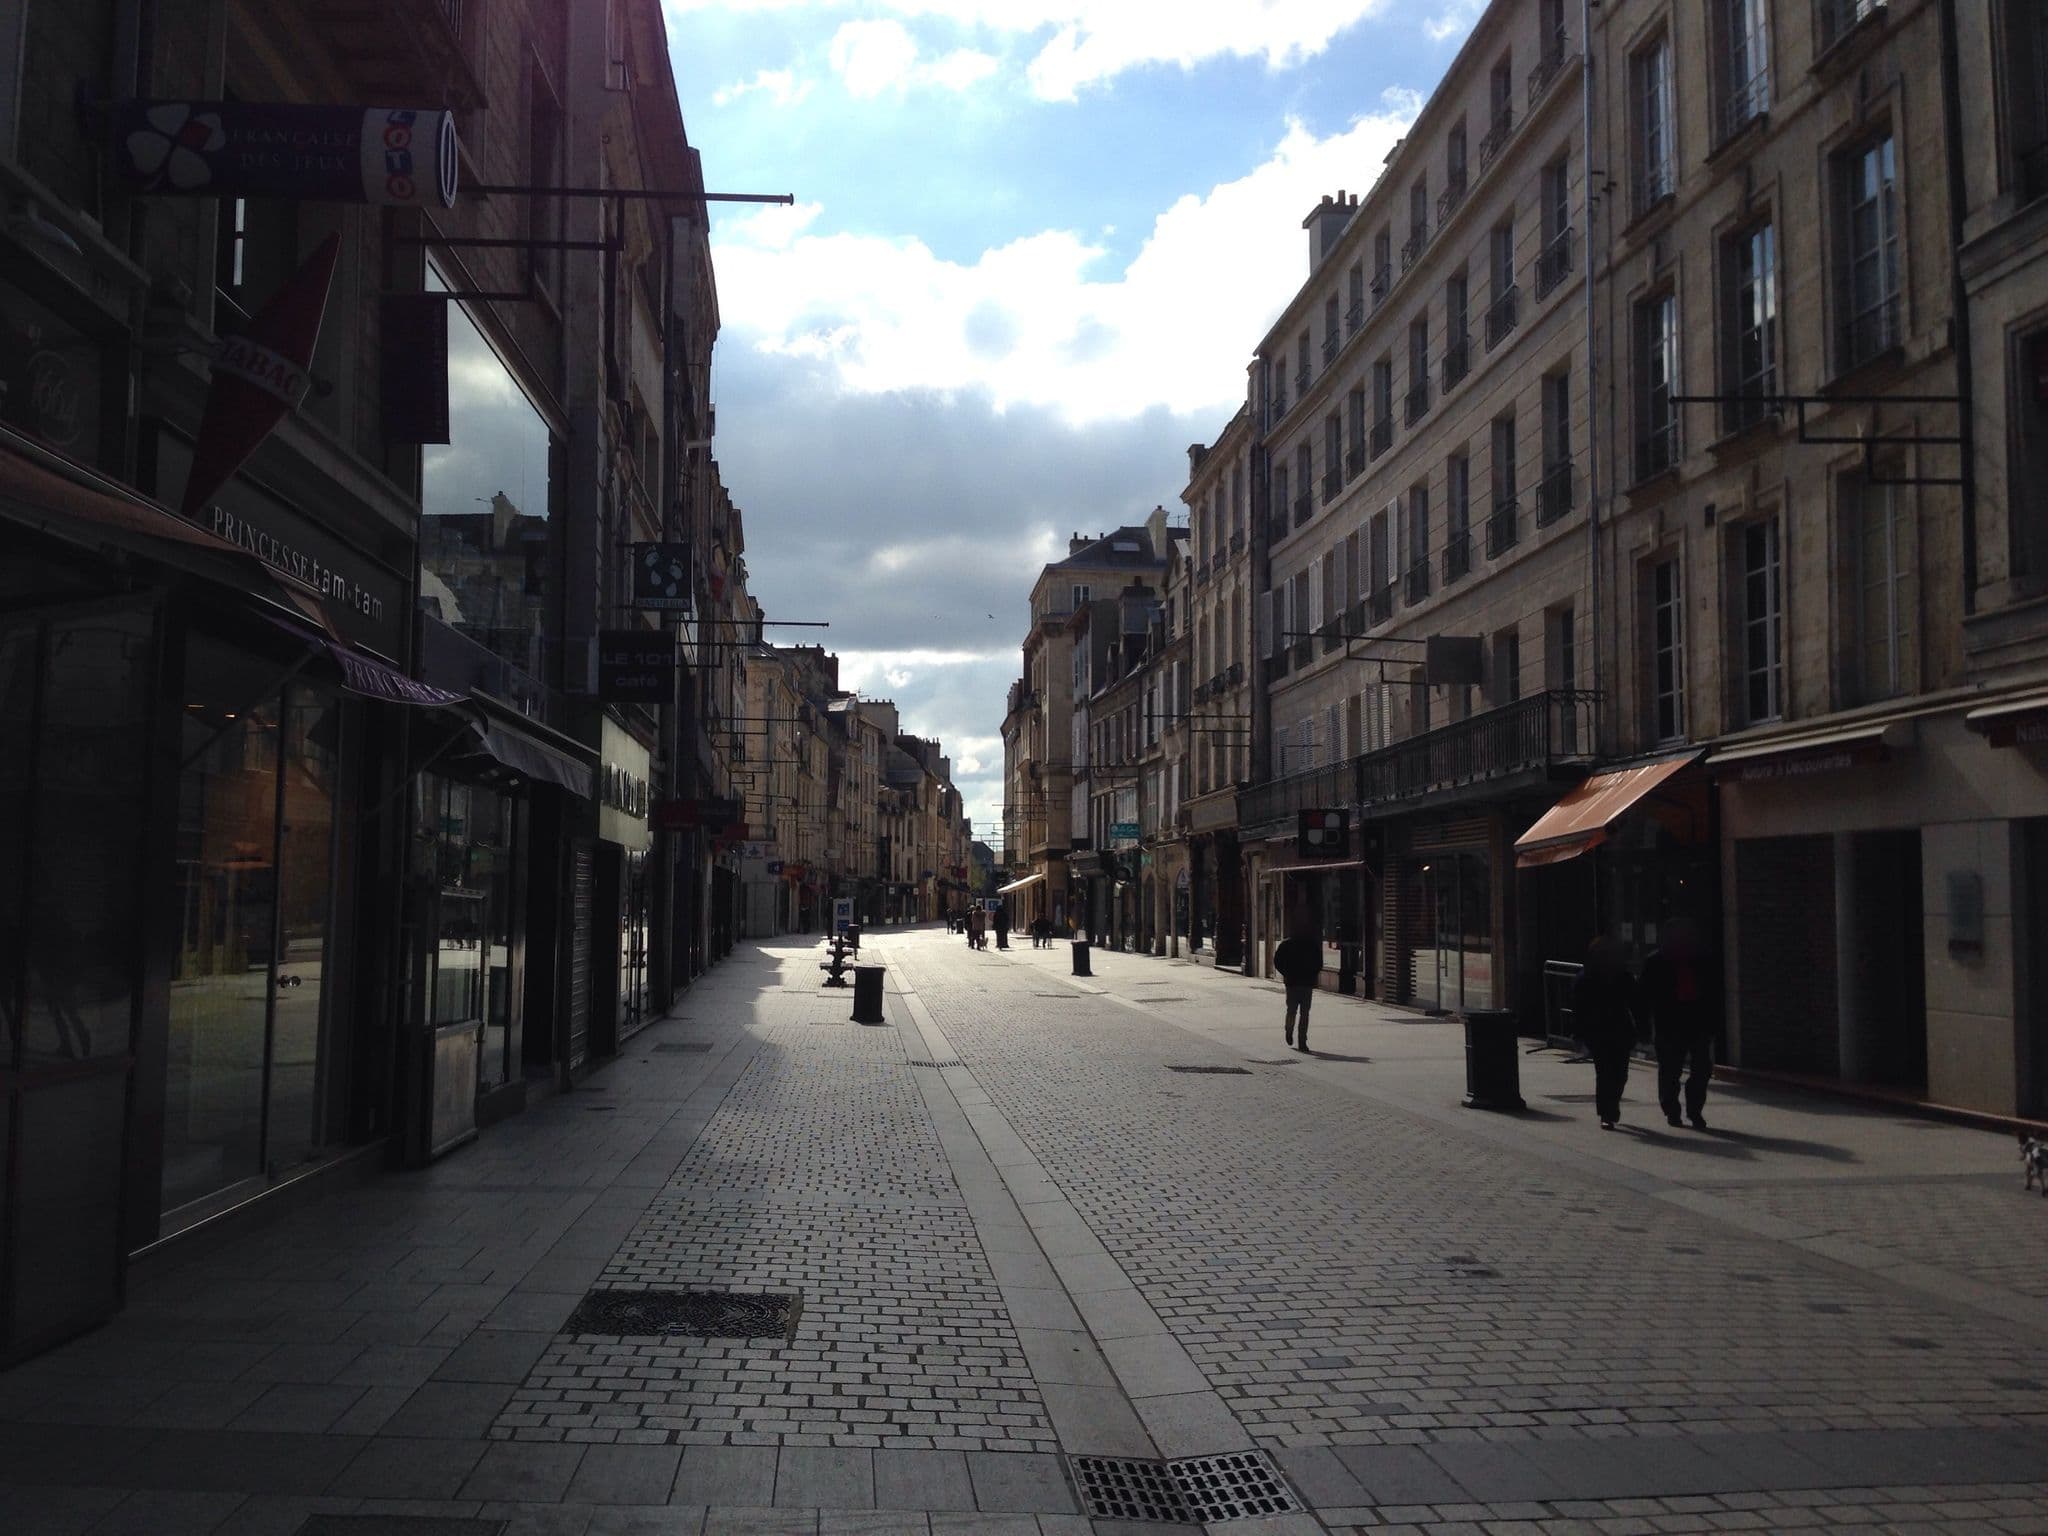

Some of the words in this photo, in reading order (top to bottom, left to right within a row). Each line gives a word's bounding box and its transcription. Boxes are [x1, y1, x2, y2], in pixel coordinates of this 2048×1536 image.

[385, 111, 417, 200] LOTO
[221, 341, 301, 398] TABAC
[213, 505, 309, 580] PRINCESSE
[602, 652, 629, 665] LE
